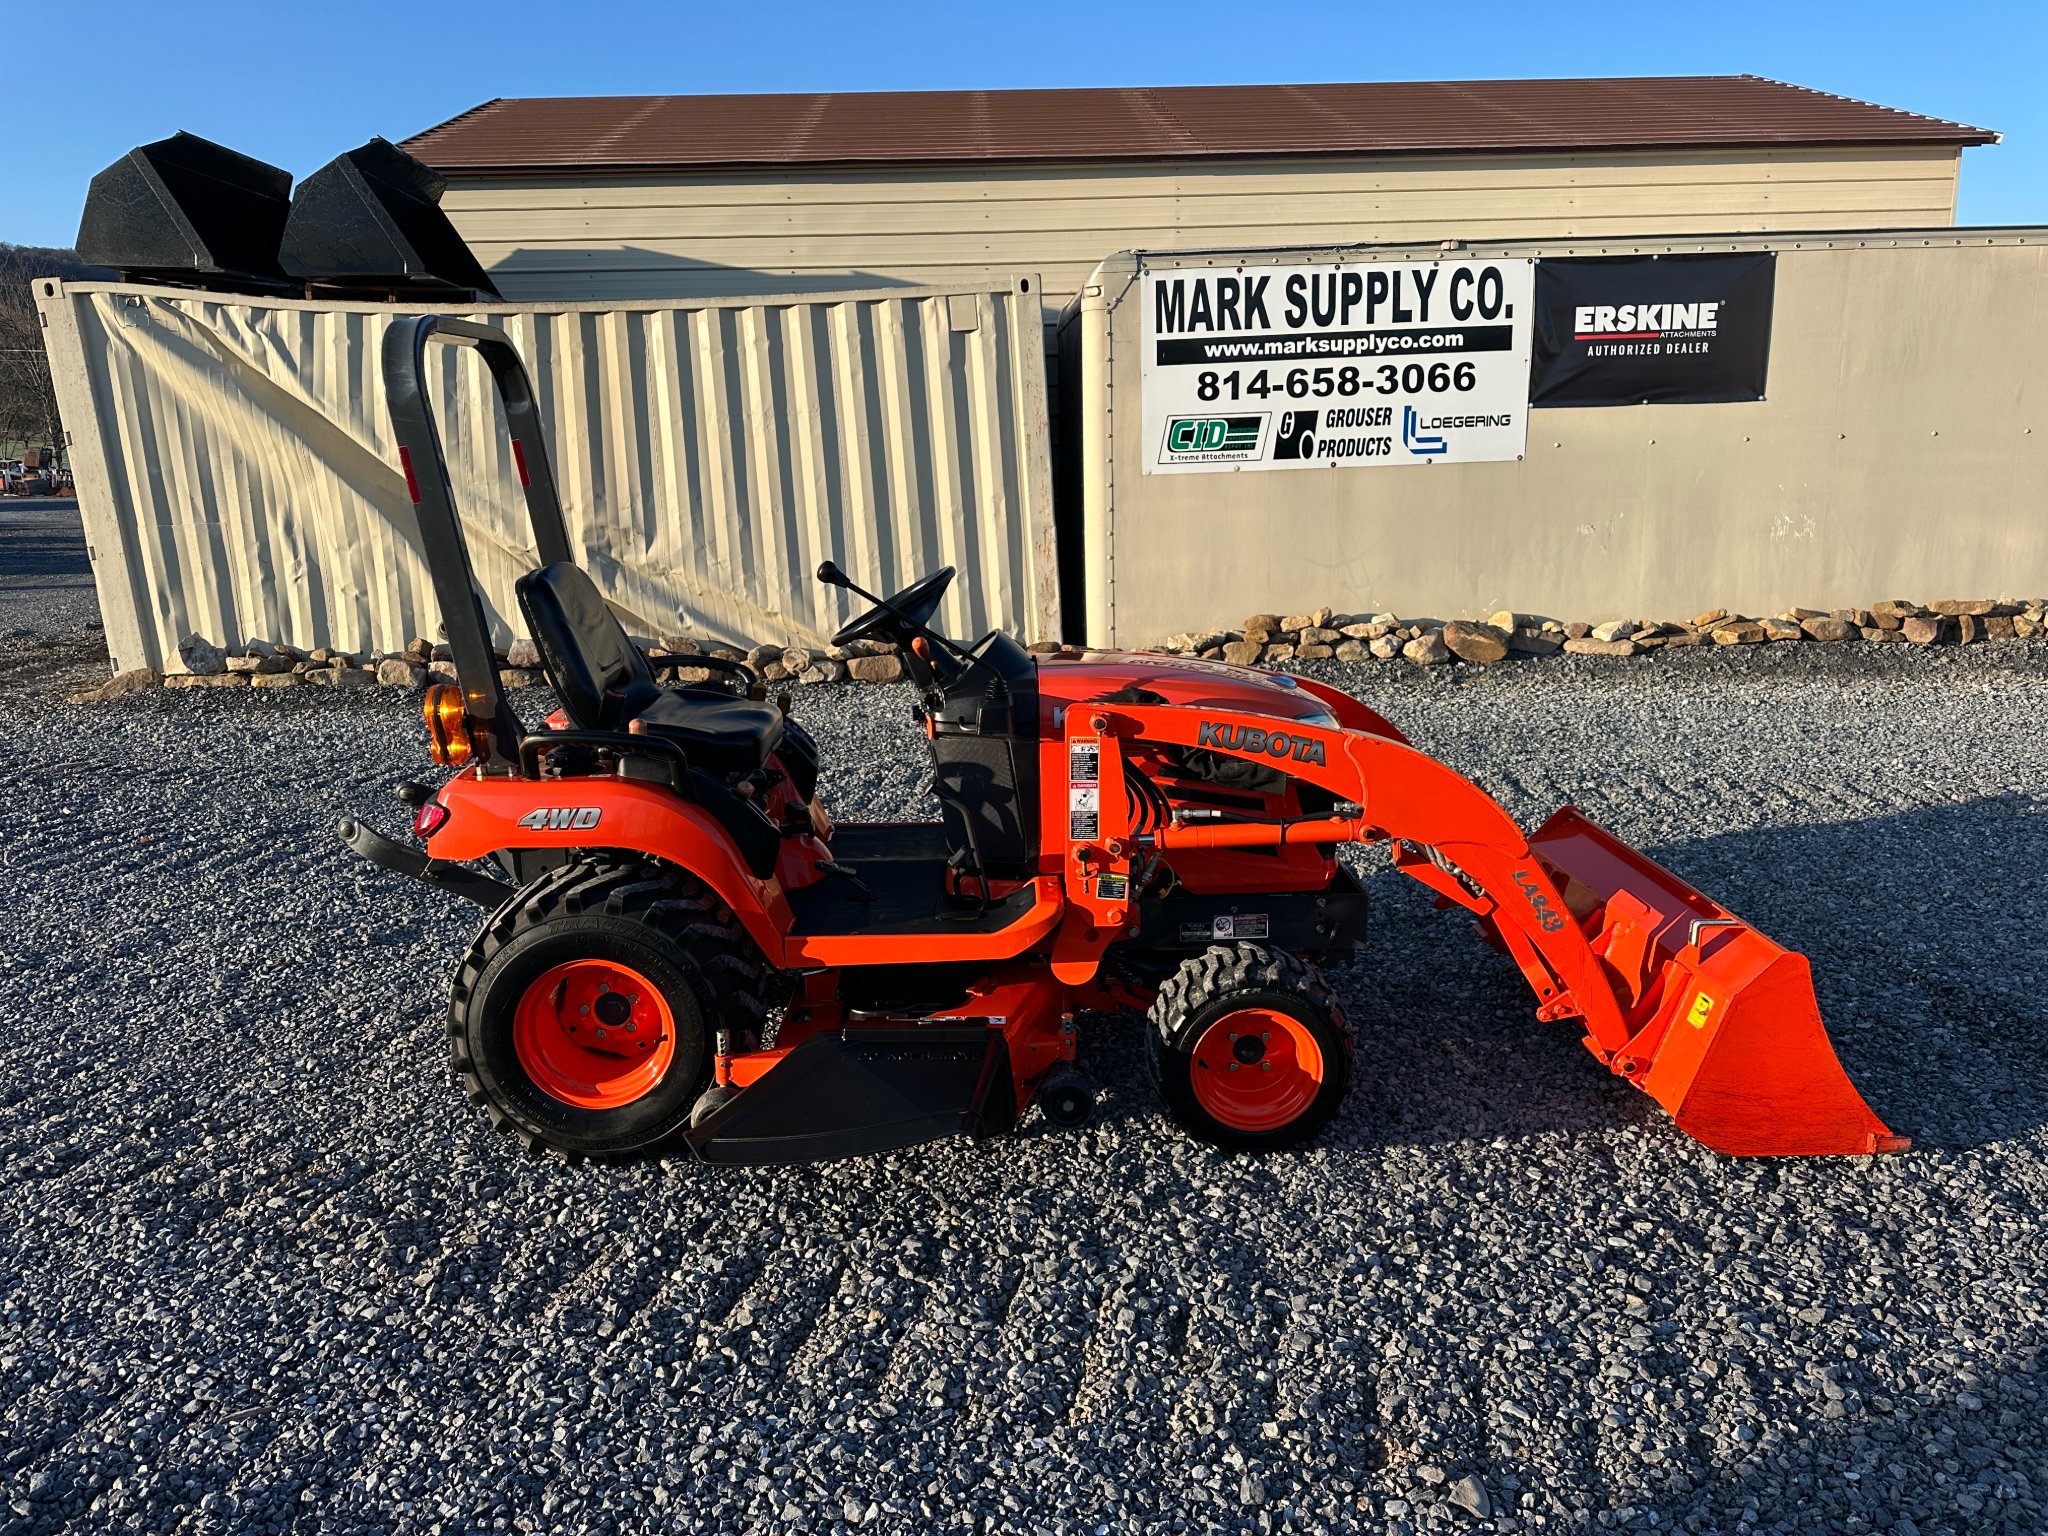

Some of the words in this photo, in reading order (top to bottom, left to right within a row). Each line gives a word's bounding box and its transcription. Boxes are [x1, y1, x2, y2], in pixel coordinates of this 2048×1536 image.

[1155, 276, 1271, 333] MARK
[1285, 269, 1439, 328] SUPPLY
[1450, 266, 1514, 321] CO.
[1575, 303, 1718, 332] ERSKINE
[1204, 333, 1464, 358] www.marksupplyco.com
[1659, 330, 1717, 338] ATTACHMENTS
[1587, 344, 1660, 357] AUTHORIZED
[1666, 342, 1709, 354] DEALER
[1197, 362, 1476, 401] 814-658-3066
[1326, 407, 1392, 428] GROUSER
[1420, 414, 1511, 429] LOEGERING
[1170, 419, 1228, 452] CID
[1317, 437, 1392, 458] PRODUCTS
[1202, 453, 1248, 461] Attachments
[1198, 721, 1326, 767] KUBOTA
[517, 807, 602, 831] 4WD
[1512, 869, 1565, 932] LA243
